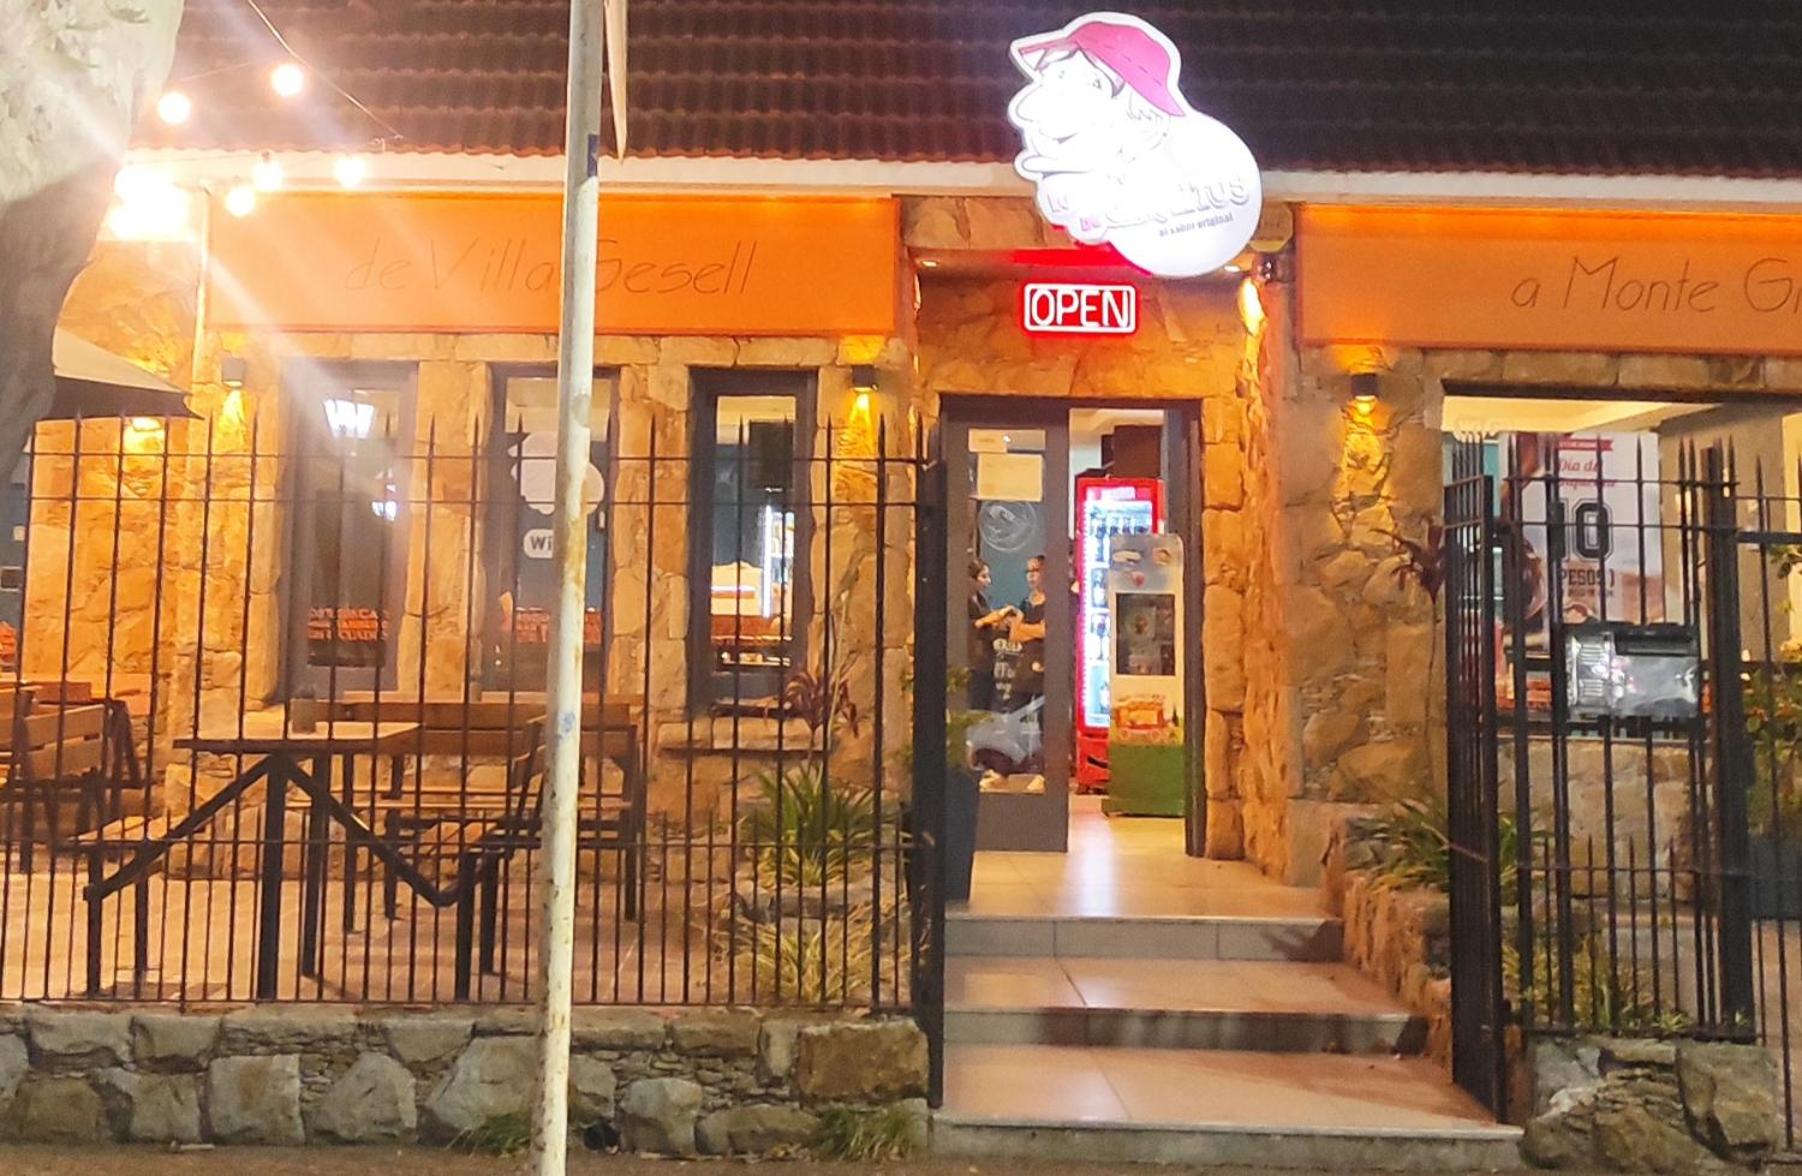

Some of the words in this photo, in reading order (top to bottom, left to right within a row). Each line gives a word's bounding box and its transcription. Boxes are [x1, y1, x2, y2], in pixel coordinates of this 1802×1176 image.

[344, 237, 411, 290] de
[430, 237, 555, 292] Villa
[1511, 277, 1541, 307] a
[1562, 255, 1718, 311] Monte
[1031, 287, 1129, 328] OPEN
